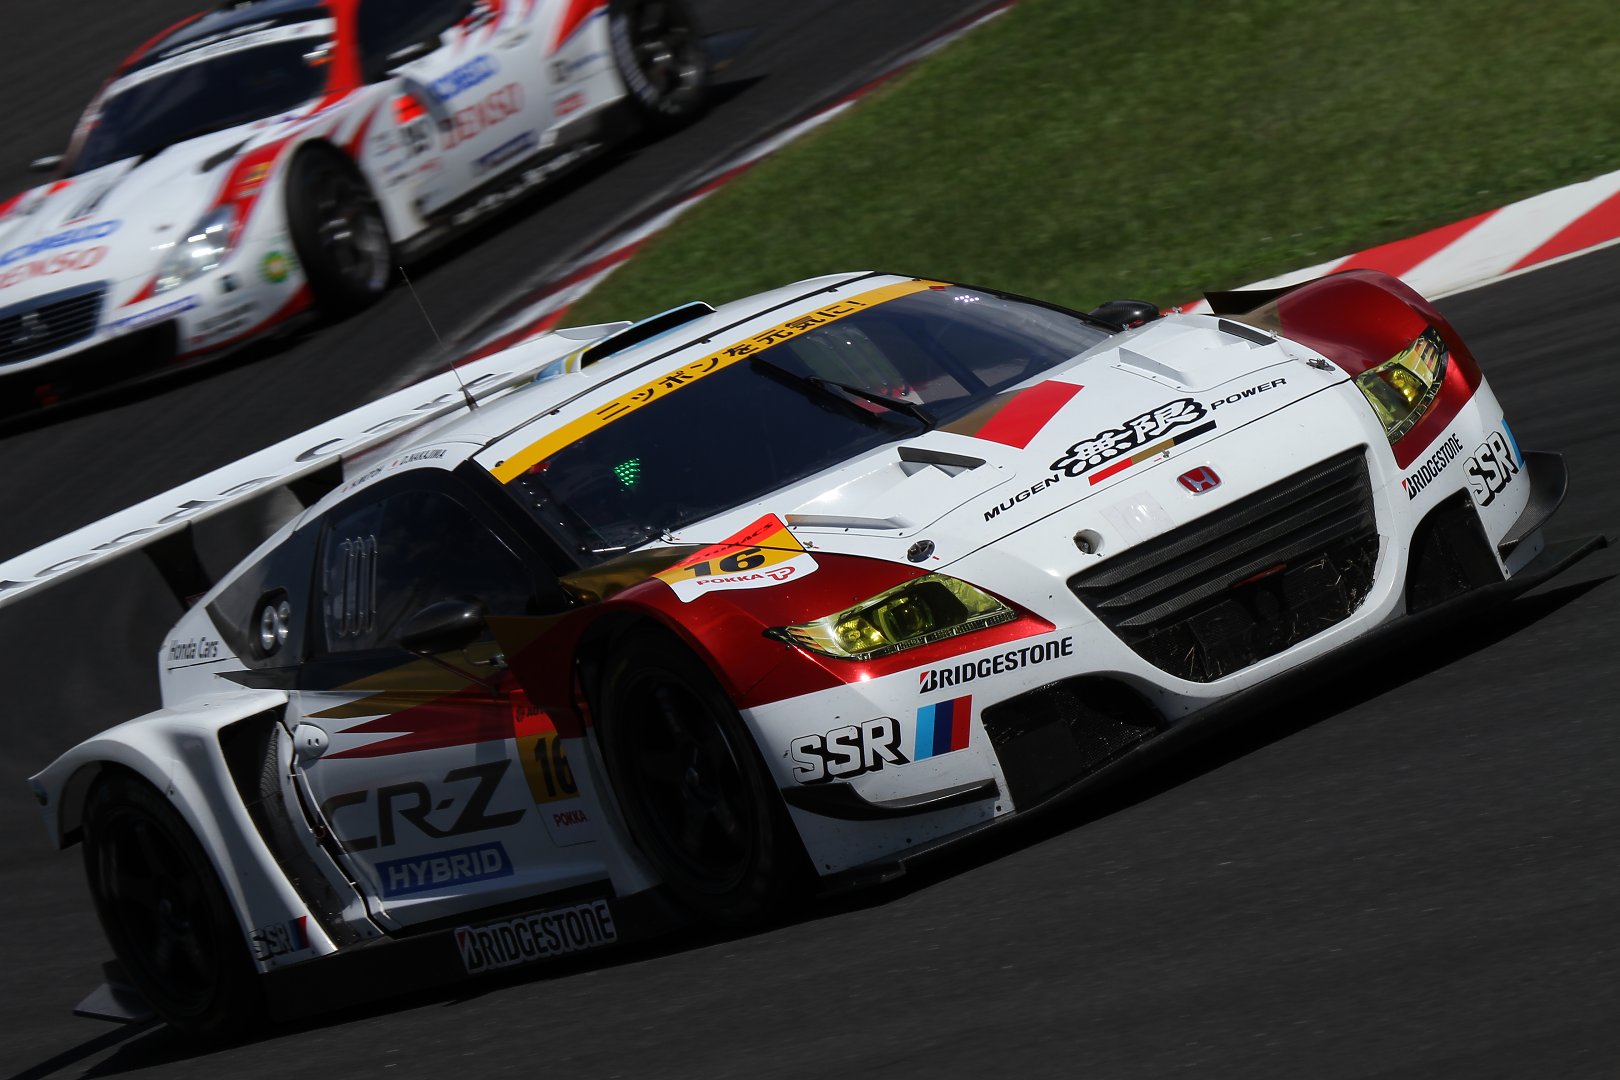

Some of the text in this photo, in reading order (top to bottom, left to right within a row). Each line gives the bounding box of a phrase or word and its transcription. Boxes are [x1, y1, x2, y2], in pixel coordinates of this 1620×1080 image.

[596, 300, 867, 411] ニッポンを元気に!
[983, 377, 1288, 523] MUGEN 無限 POWER
[1401, 432, 1464, 501] BRIDGESTONE
[1462, 430, 1520, 507] SSR
[683, 546, 766, 578] 16
[696, 572, 766, 586] POKKA
[168, 636, 219, 661] Honda Cars
[919, 635, 1074, 695] BRIDGESTONE
[534, 736, 579, 798] 16
[789, 716, 911, 786] SSR
[321, 758, 527, 854] CR-Z
[553, 809, 588, 827] POKKA
[386, 847, 504, 892] HYBRID
[247, 921, 296, 962] SSR
[456, 902, 617, 973] BRIDGESTONE
